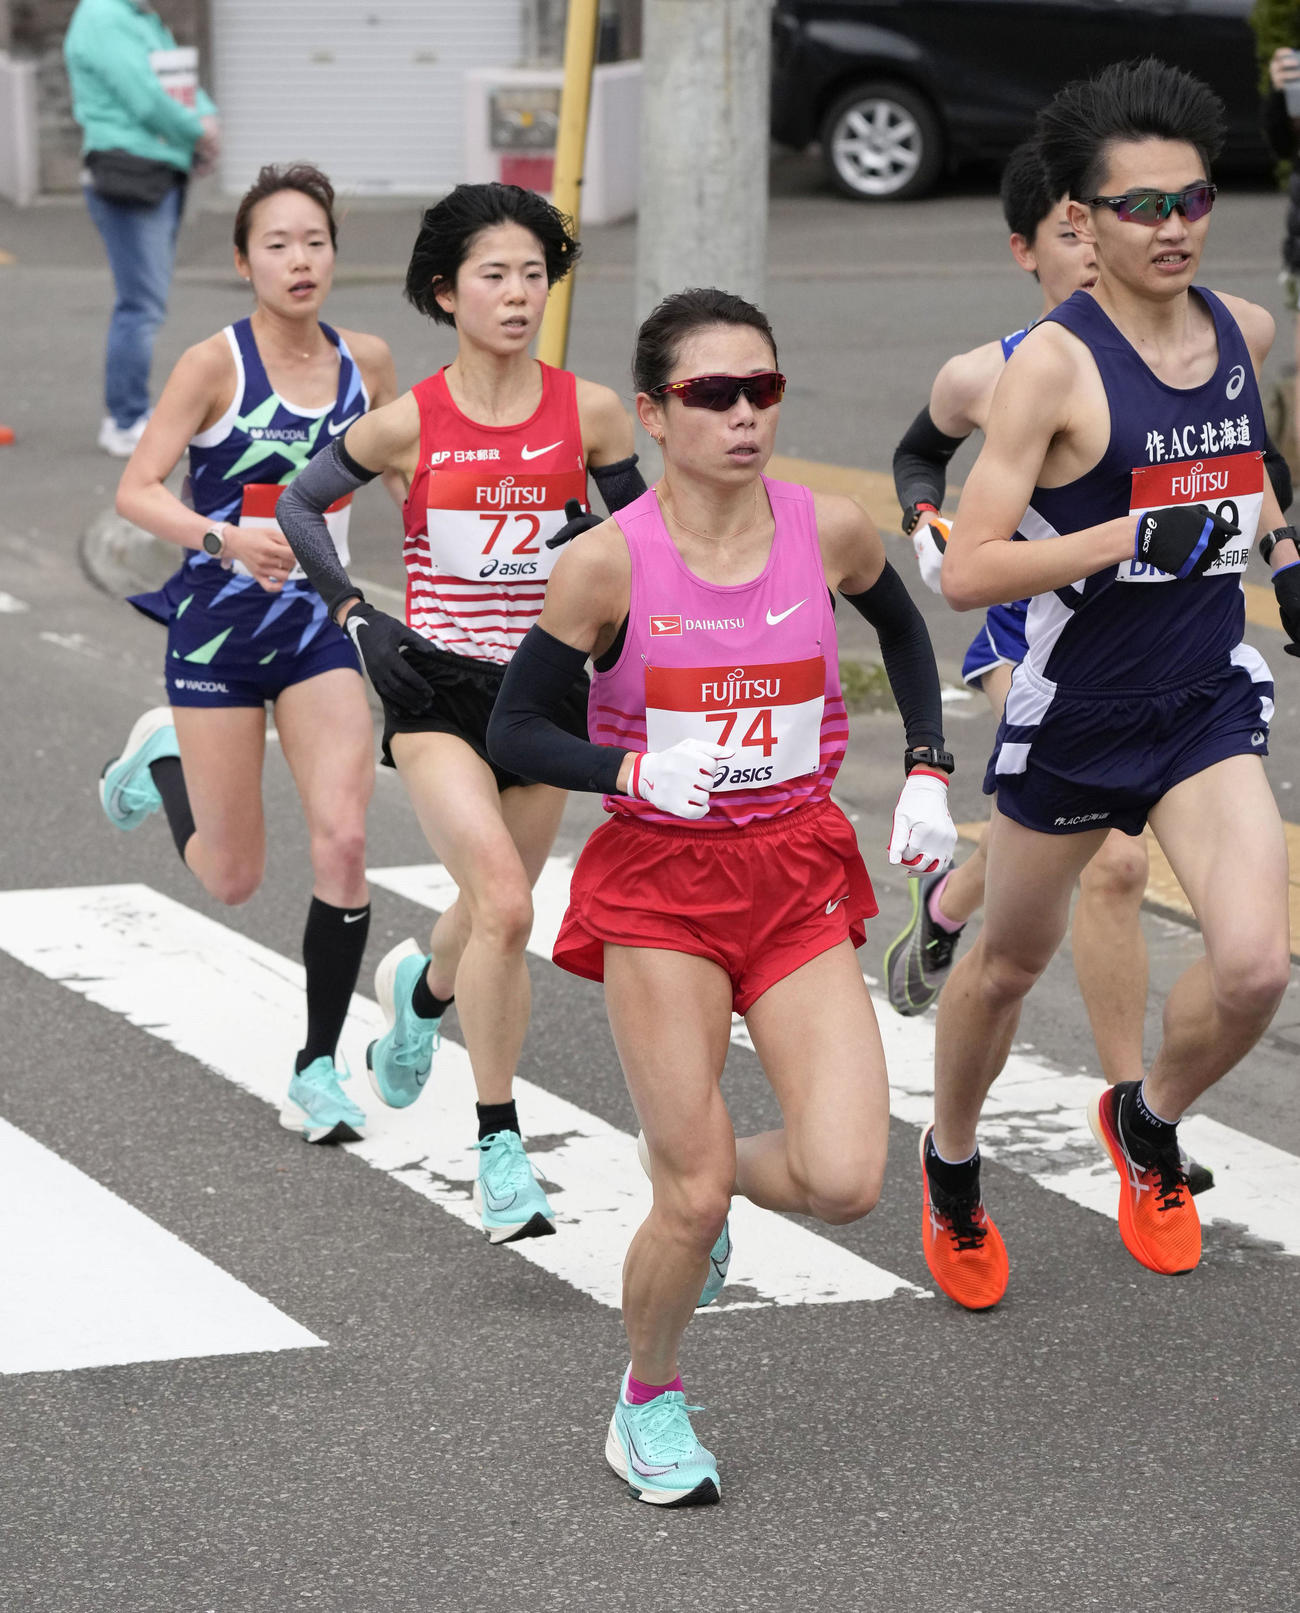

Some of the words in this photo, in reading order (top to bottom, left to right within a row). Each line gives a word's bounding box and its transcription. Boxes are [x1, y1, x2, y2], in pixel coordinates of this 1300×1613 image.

[264, 429, 308, 440] WACOAL
[454, 448, 501, 463] 日本郵政
[1171, 462, 1229, 500] FUJITSU
[476, 476, 546, 509] FUJITSU
[479, 513, 541, 555] 72
[1142, 528, 1153, 553] asics
[499, 562, 538, 575] asics
[685, 617, 746, 631] DAIHATSU
[185, 679, 230, 693] WACOAL
[701, 668, 782, 707] FUJITSU
[705, 709, 779, 757] 74
[729, 765, 774, 784] asics
